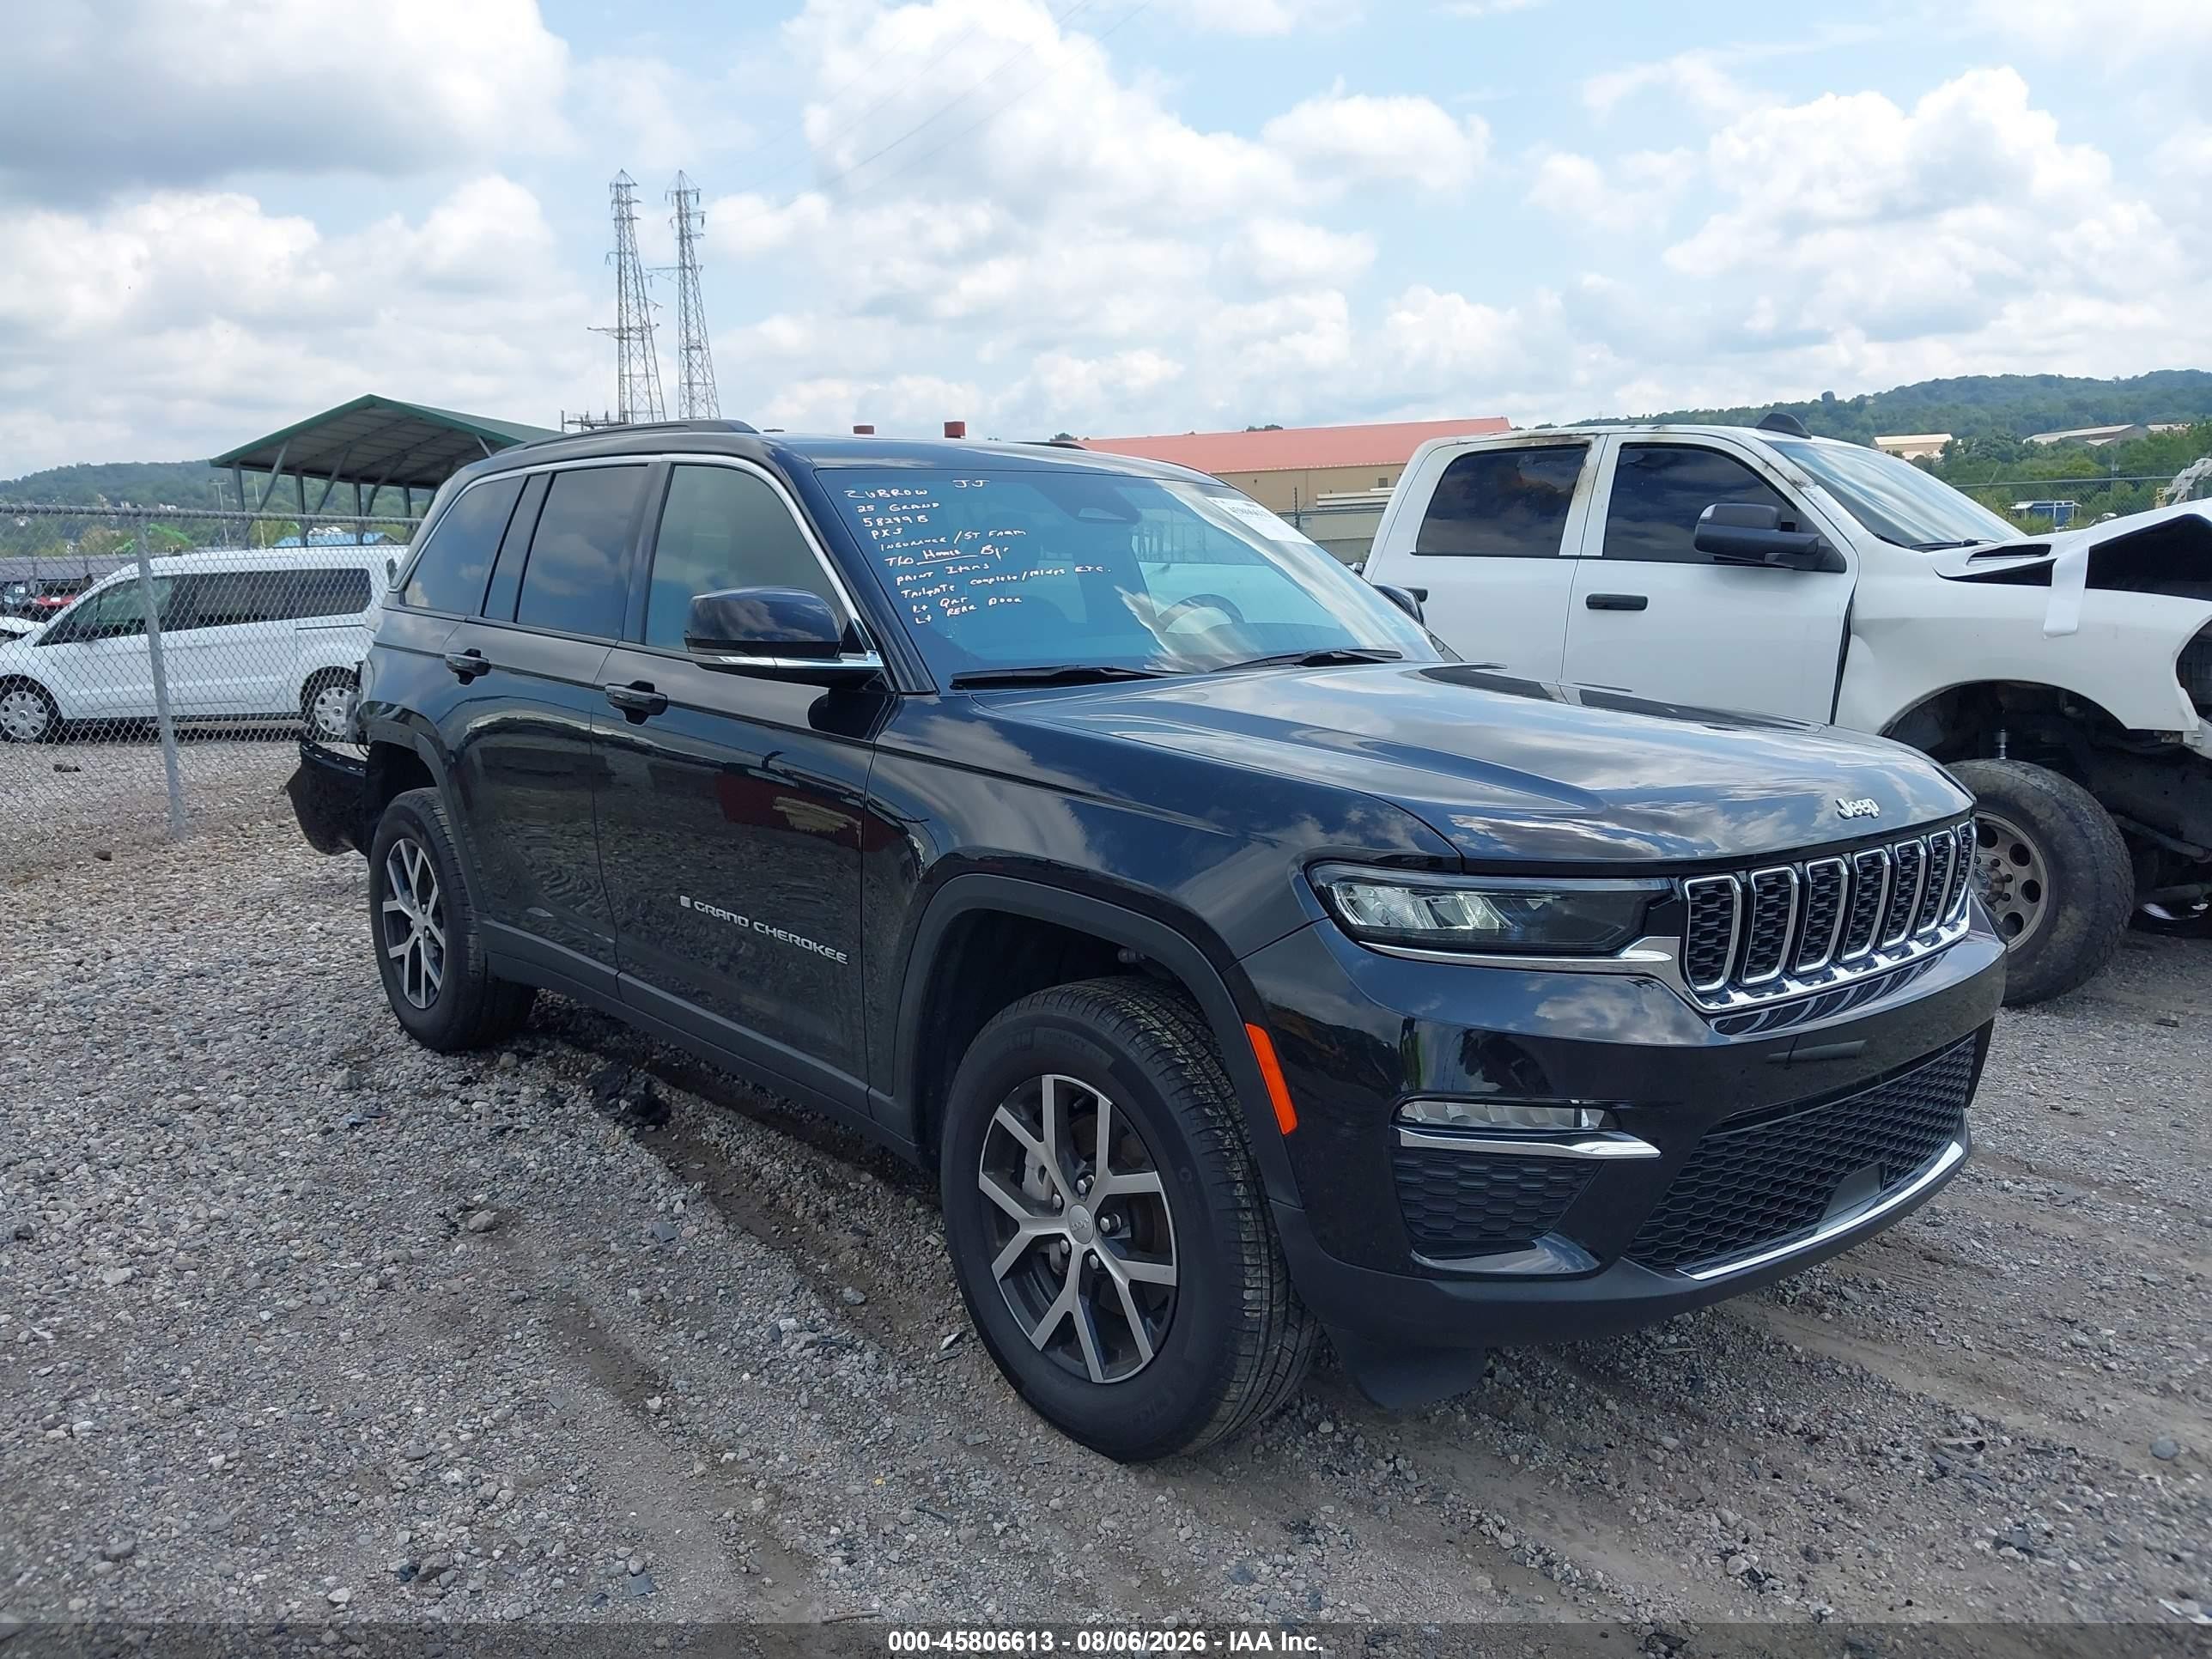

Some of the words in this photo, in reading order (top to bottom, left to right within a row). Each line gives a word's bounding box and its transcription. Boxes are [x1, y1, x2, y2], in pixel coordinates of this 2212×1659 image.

[856, 504, 875, 513] 25
[1835, 798, 1880, 819] Jeep
[693, 900, 750, 928] GRAND
[753, 921, 849, 965] CHEROKEE
